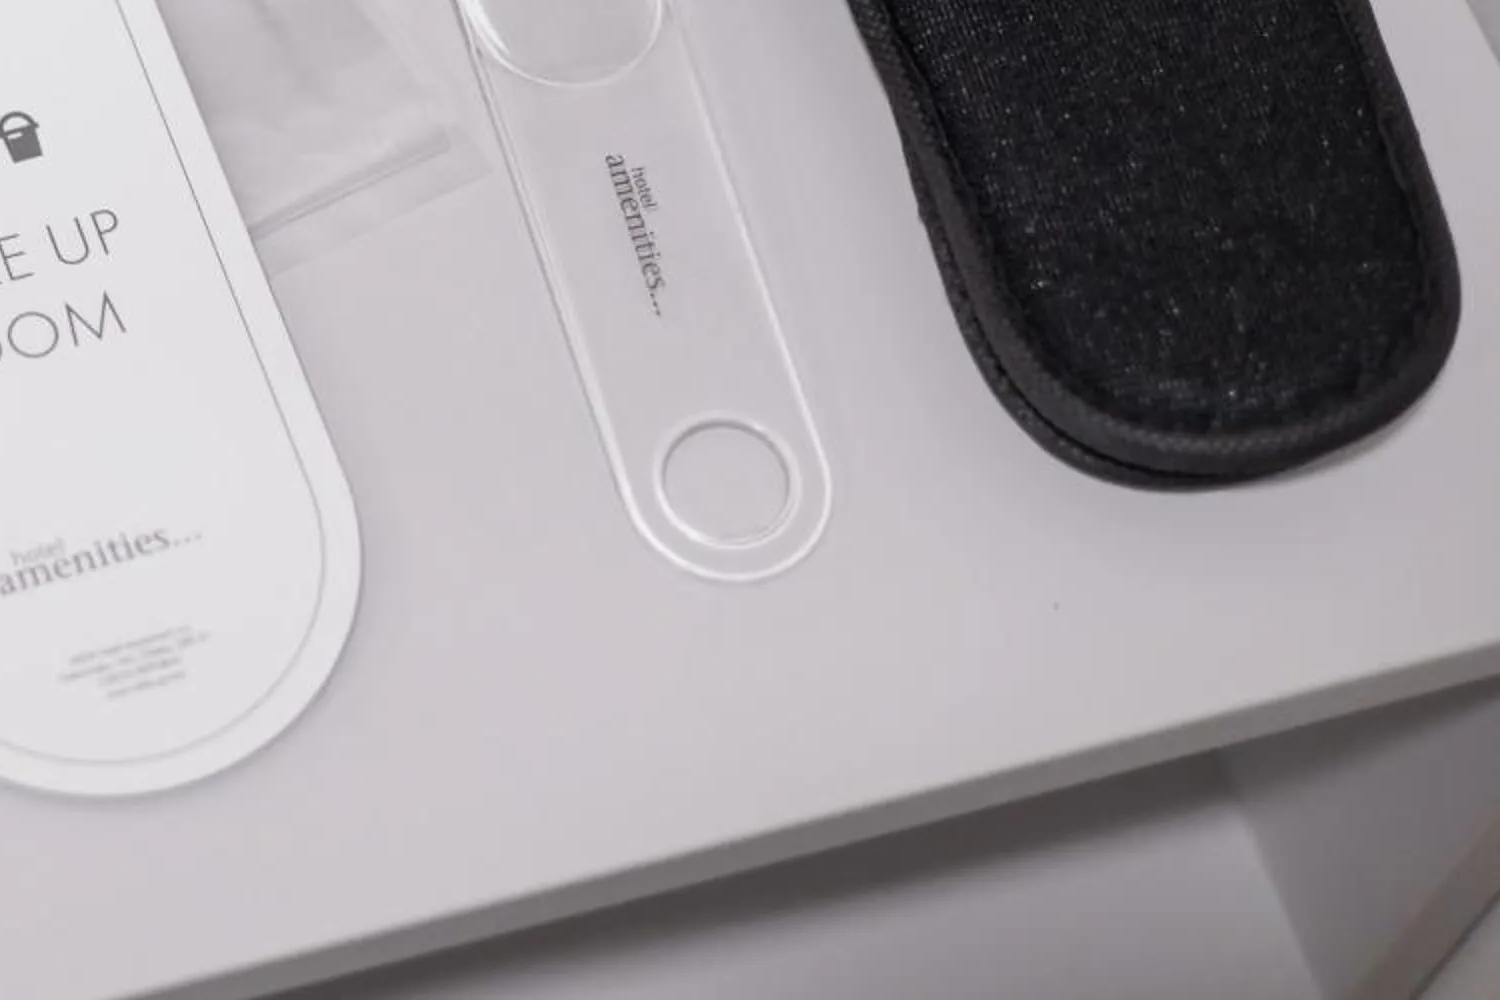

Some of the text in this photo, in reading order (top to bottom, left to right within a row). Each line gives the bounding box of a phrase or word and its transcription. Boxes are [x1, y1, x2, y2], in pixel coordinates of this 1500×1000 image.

[630, 166, 658, 210] hotel
[46, 209, 118, 266] UP
[9, 536, 66, 567] hotel
